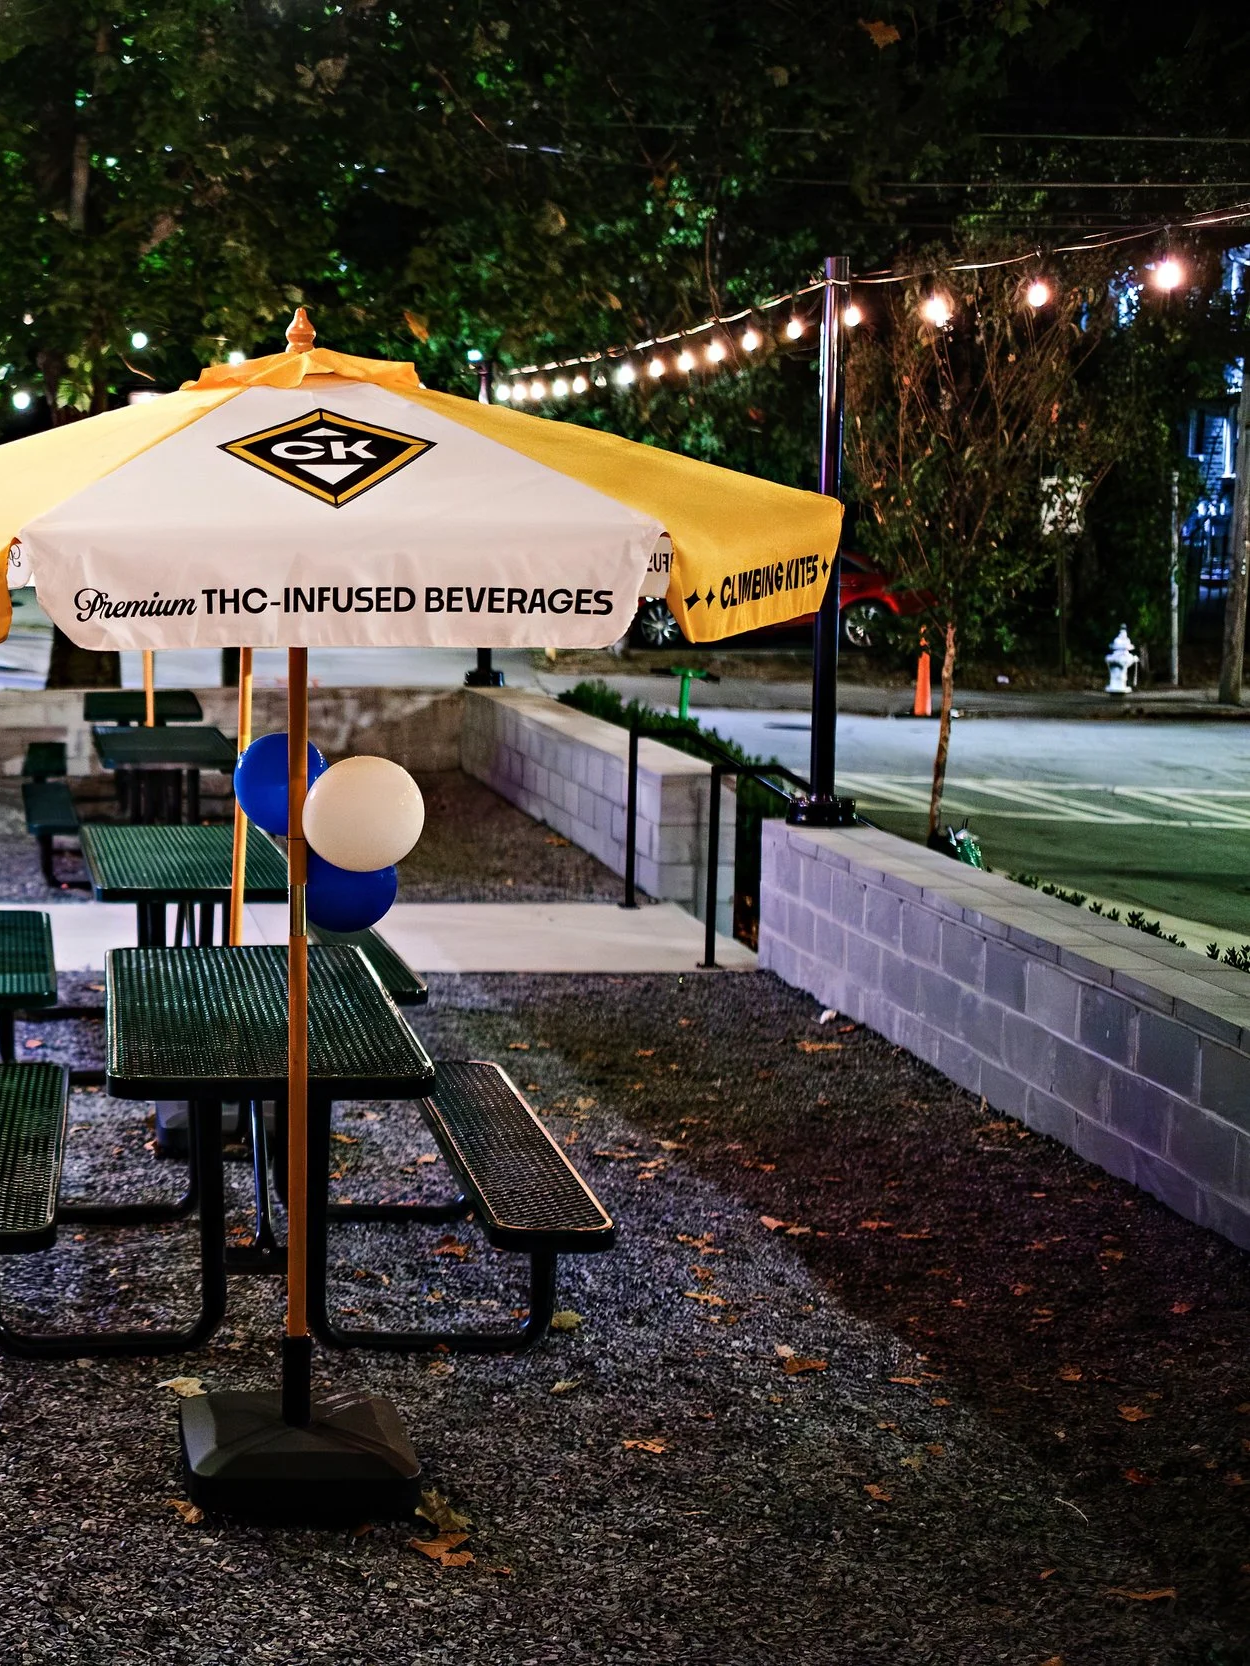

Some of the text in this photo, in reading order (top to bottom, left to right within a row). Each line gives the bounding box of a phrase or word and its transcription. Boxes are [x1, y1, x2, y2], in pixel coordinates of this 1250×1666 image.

[271, 440, 378, 460] CK
[720, 561, 784, 610] CLIMBING
[785, 554, 819, 592] KITES
[74, 587, 614, 622] Premium THC-INFUSED BEVERAGES
